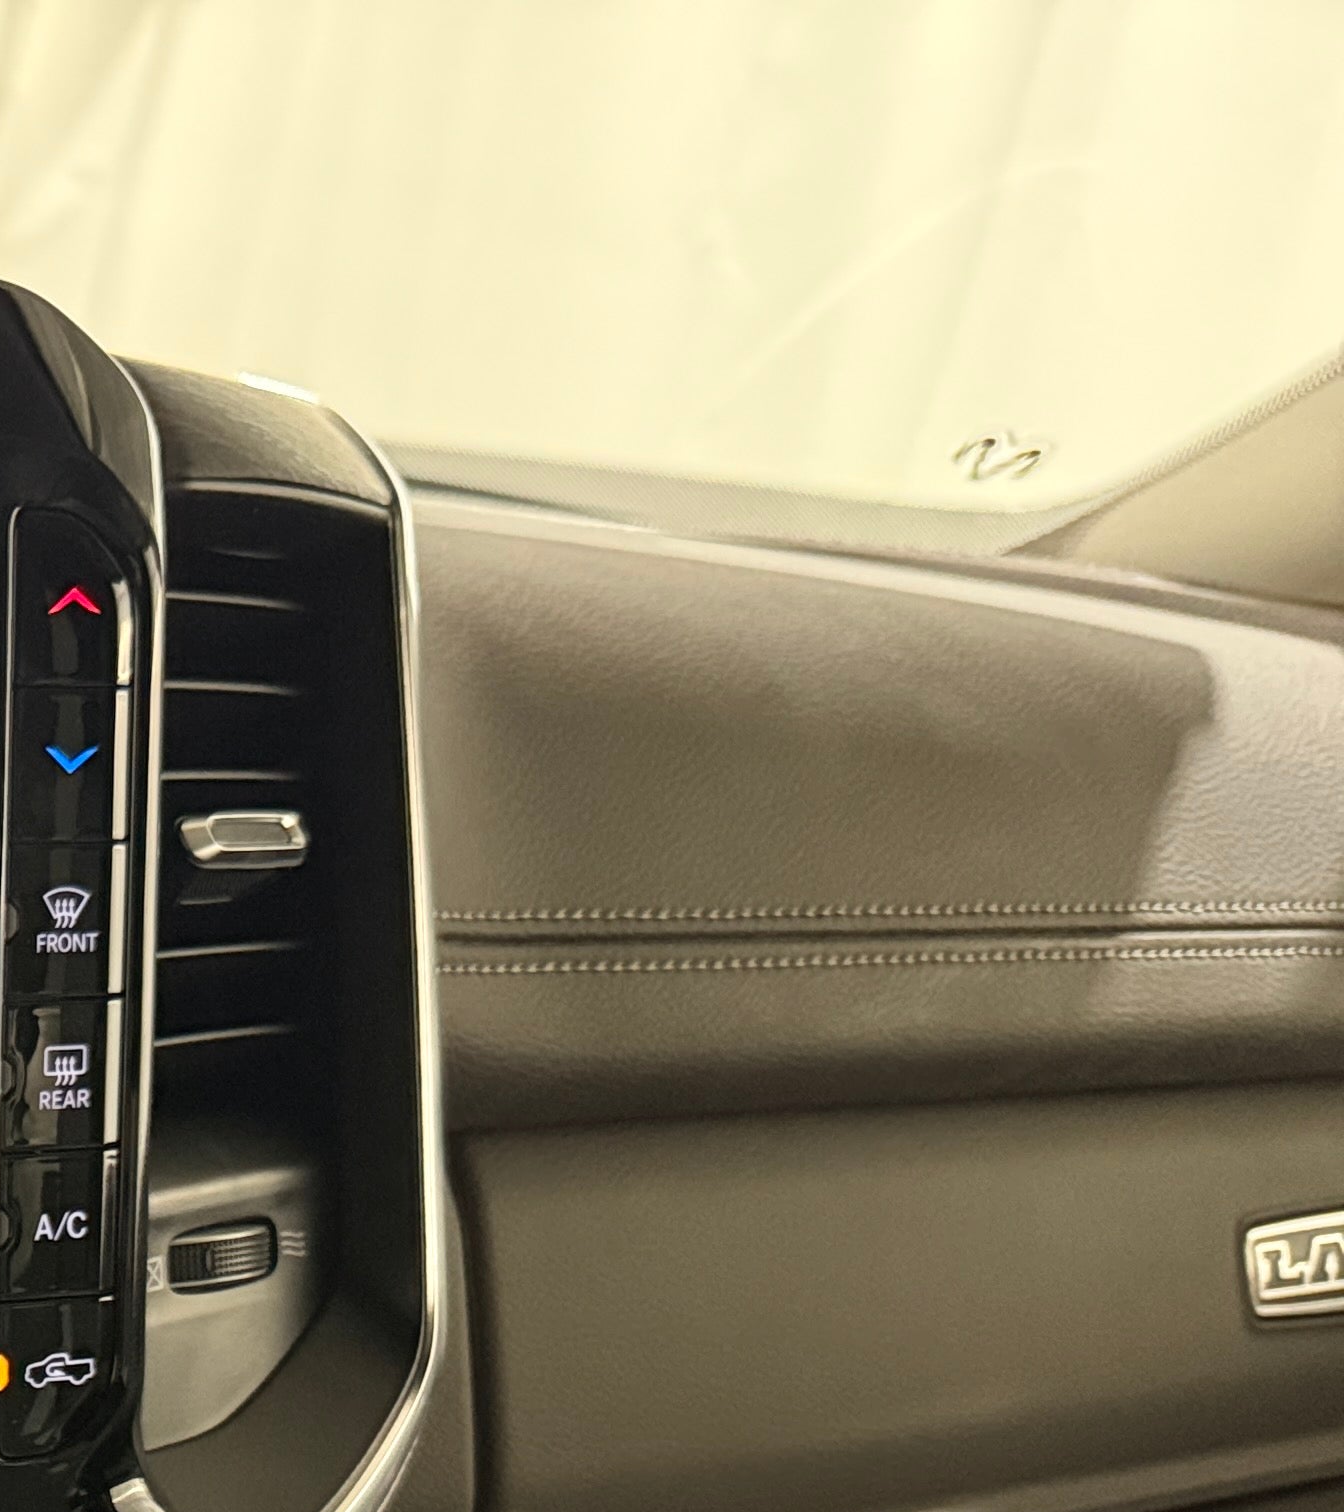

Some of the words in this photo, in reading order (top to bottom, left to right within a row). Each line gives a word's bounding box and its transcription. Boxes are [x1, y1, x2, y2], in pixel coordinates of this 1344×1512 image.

[36, 933, 98, 954] FRONT
[38, 1090, 90, 1110] REAR
[34, 1211, 88, 1241] A/C
